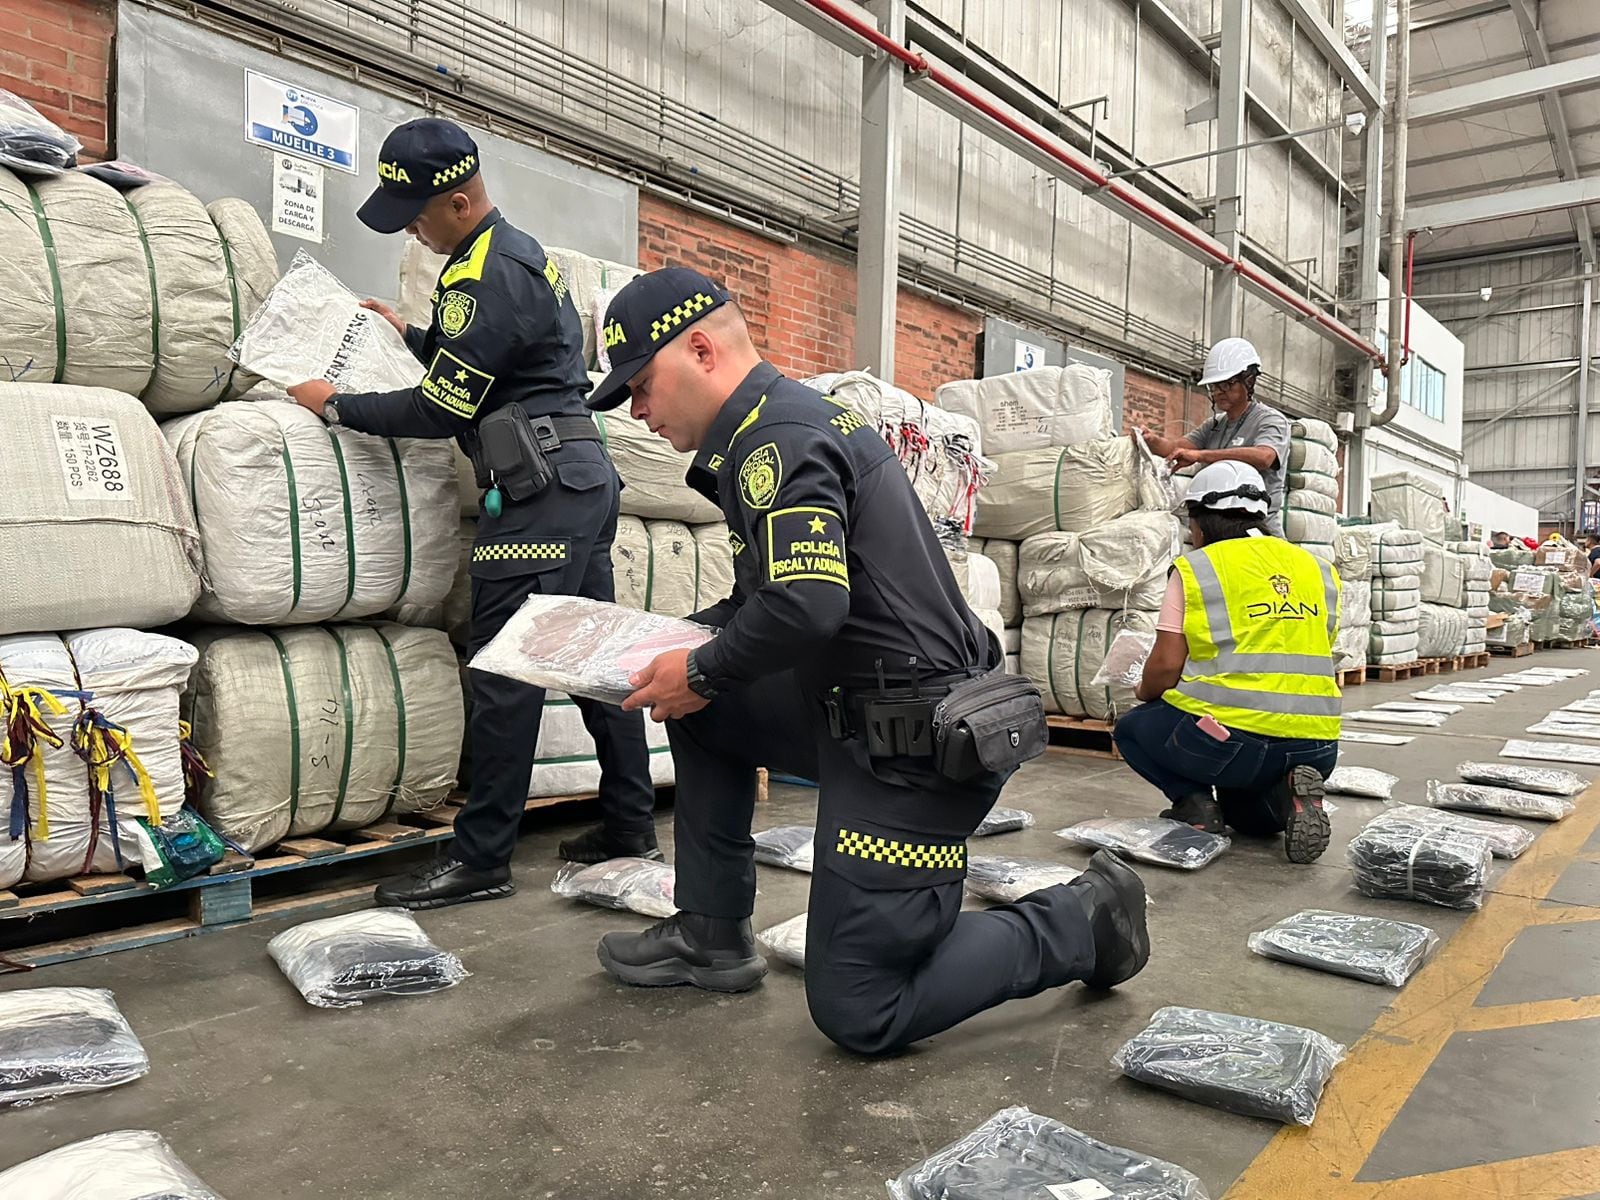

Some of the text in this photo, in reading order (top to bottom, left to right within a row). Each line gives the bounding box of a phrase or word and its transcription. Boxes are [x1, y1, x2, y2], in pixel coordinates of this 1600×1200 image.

[272, 130, 335, 160] MUELLE 3
[284, 199, 315, 213] ZONA DE
[284, 209, 307, 220] CARGA
[279, 216, 315, 232] DESCARGA
[437, 375, 471, 401] POLICÍA
[439, 388, 447, 400] Y
[64, 448, 77, 465] 150
[80, 444, 99, 482] TP-2262
[91, 425, 124, 492] WZ688
[68, 466, 83, 487] PCS
[790, 540, 841, 559] POLICÍA
[772, 557, 805, 576] FISCAL
[804, 557, 813, 570] Y
[1247, 601, 1318, 618] DIAN
